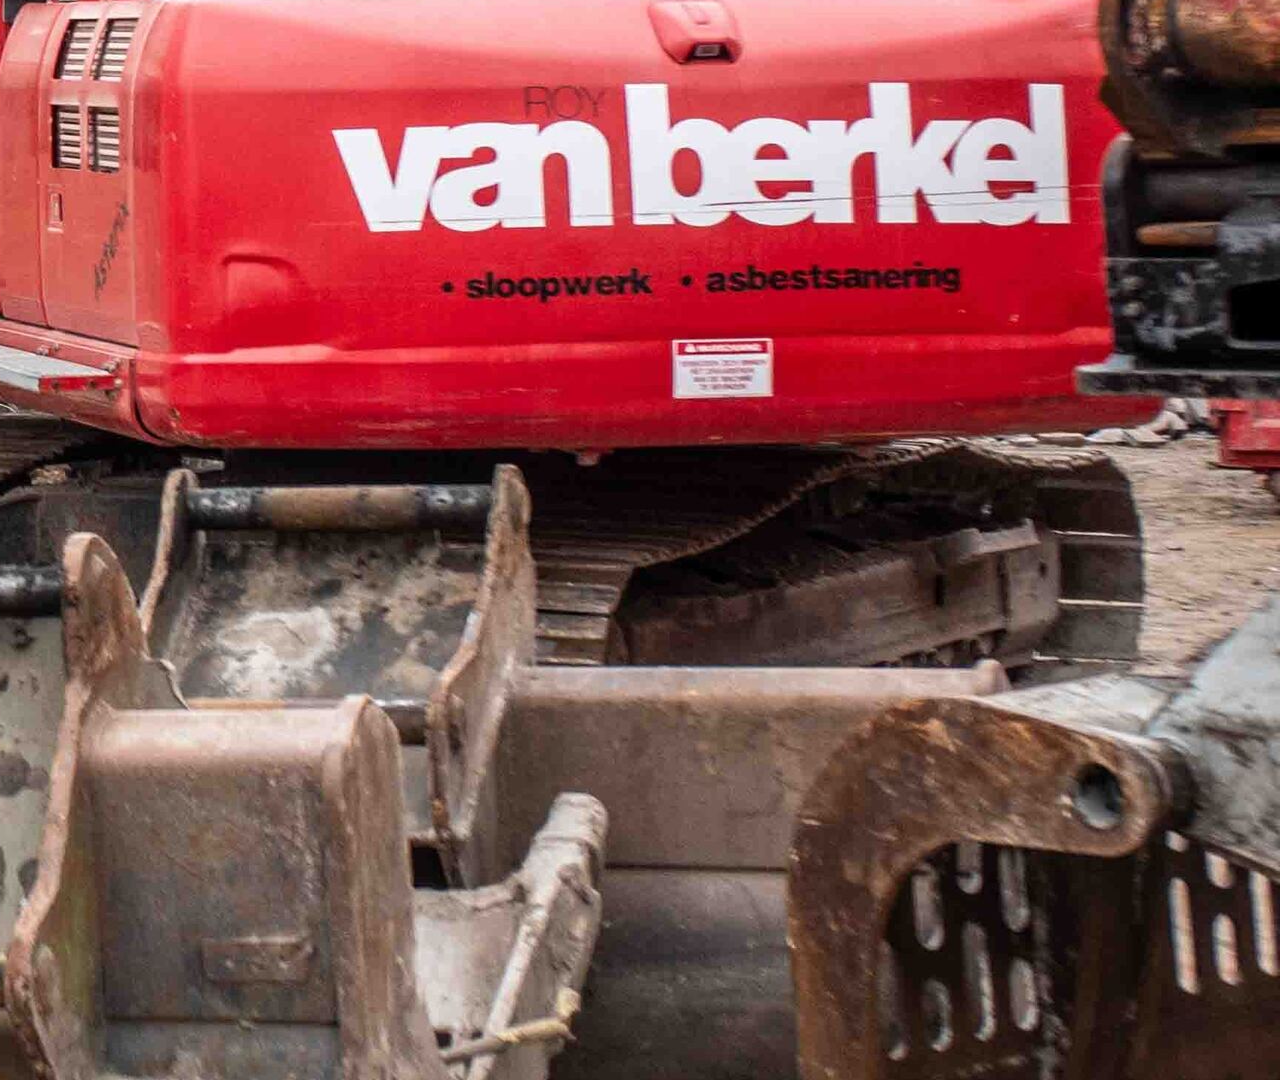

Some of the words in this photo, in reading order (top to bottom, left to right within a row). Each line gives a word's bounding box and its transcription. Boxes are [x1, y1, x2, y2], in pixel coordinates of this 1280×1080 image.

[524, 85, 605, 119] ROY
[467, 268, 653, 303] sloopwerk
[705, 261, 962, 294] asbestsanering
